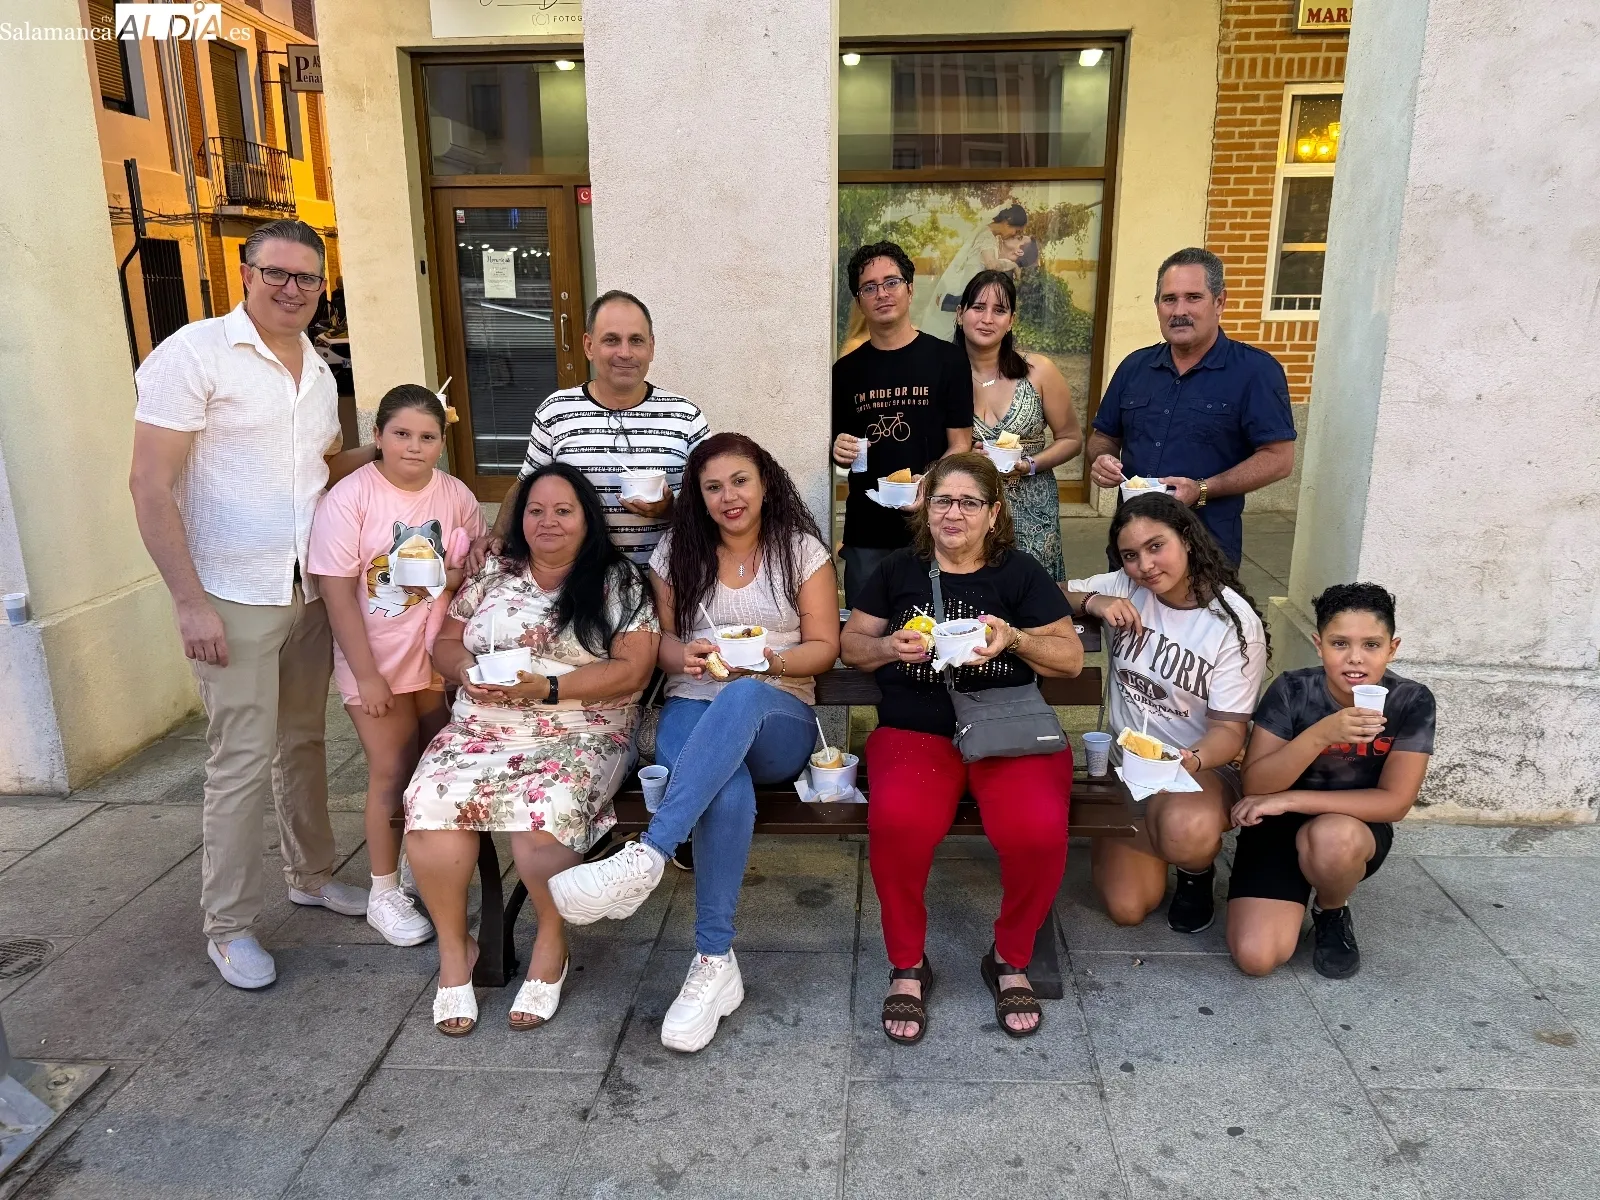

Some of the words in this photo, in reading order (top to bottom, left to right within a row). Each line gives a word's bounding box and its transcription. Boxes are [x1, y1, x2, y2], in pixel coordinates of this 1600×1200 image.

[869, 388, 892, 399] RIDE
[894, 386, 908, 396] OR
[912, 386, 929, 396] DIE
[1149, 633, 1214, 700] YORK
[1128, 672, 1156, 698] USA
